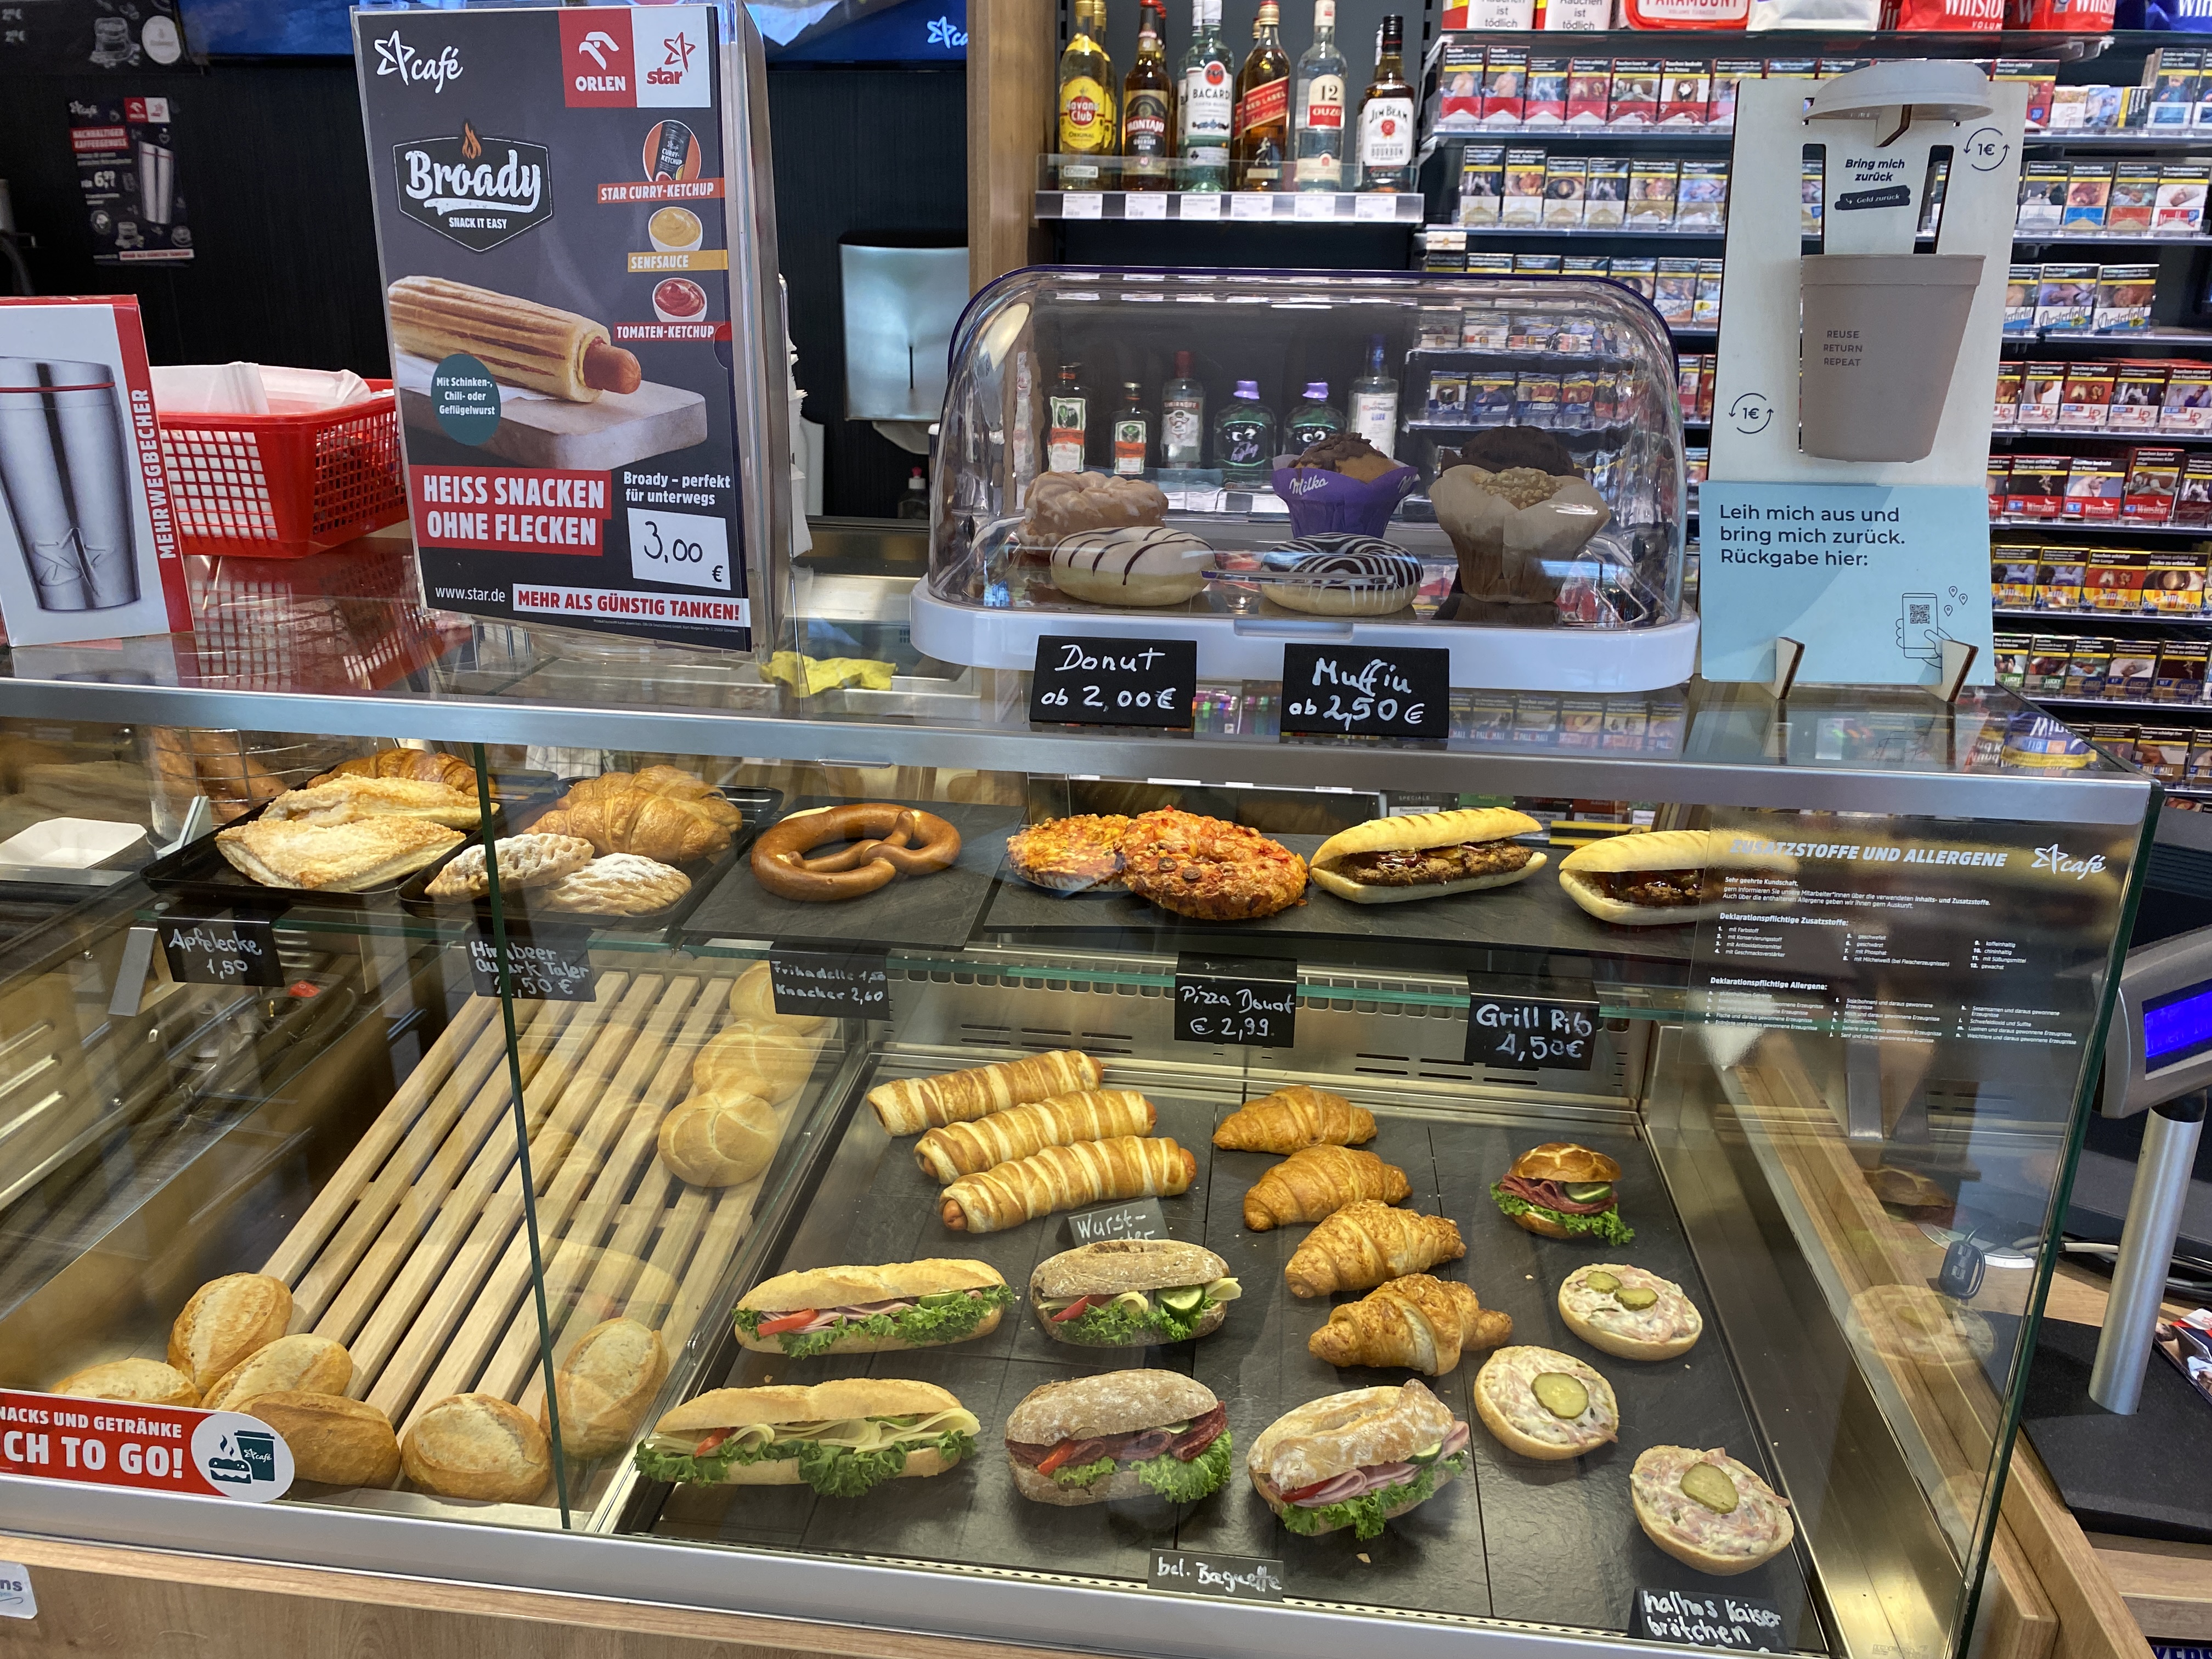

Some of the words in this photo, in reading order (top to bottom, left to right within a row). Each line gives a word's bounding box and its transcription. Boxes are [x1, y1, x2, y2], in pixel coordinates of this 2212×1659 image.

[1496, 7, 1508, 15] ist
[1573, 8, 1586, 18] ist
[411, 46, 464, 93] café
[646, 67, 683, 86] star
[575, 75, 626, 92] ORLEN
[1320, 85, 1339, 102] 12
[1071, 111, 1092, 121] Club
[1369, 109, 1384, 123] JIM
[1387, 105, 1407, 122] BEAM
[662, 148, 679, 158] CURRY-
[1978, 144, 1995, 156] 1€
[661, 154, 682, 165] KETCHUP
[1845, 159, 1875, 171] Bring
[1878, 159, 1905, 168] mich
[405, 149, 541, 214] Broady
[1855, 171, 1893, 182] zurück
[601, 187, 626, 201] STAR
[629, 182, 714, 200] CURRY-KETCHUP
[1857, 195, 1874, 204] Geld
[1875, 193, 1900, 202] zurück
[449, 217, 476, 228] SNACK
[477, 218, 484, 228] IT
[487, 218, 507, 229] EASY
[631, 255, 689, 269] SENFSAUCE
[617, 326, 715, 338] TOMATEN-KETCHUP
[1827, 330, 1860, 338] REUSE
[1824, 344, 1863, 353] RETURN
[1824, 358, 1861, 366] REPEAT
[437, 377, 449, 386] Mit
[451, 377, 492, 388] Schinken-,
[444, 391, 465, 401] Chili-
[467, 391, 486, 402] oder
[439, 405, 495, 416] Geflügelwurst
[1743, 407, 1759, 420] 1€
[131, 389, 177, 559] MEHRWEGBECHER
[624, 472, 668, 488] Broady
[681, 475, 730, 489] perfekt
[424, 475, 487, 504] HEISS
[494, 477, 604, 508] SNACKEN
[1289, 475, 1329, 495] Milka
[626, 489, 644, 502] für
[647, 491, 715, 506] unterwegs
[1720, 504, 1759, 520] Leih
[1767, 505, 1815, 521] mich
[1821, 509, 1855, 521] aus
[1861, 507, 1900, 522] und
[427, 511, 488, 540] OHNE
[495, 514, 596, 545] FLECKEN
[1720, 527, 1771, 545] bring
[1778, 527, 1826, 543] mich
[1832, 529, 1905, 545] zurück.
[644, 521, 703, 563] 3,00
[1720, 549, 1819, 568] Rückgabe
[1825, 550, 1869, 566] hier:
[712, 565, 723, 582] €
[436, 585, 505, 603] www.star.de
[518, 590, 560, 608] MEHR
[565, 594, 592, 610] ALS
[597, 592, 665, 616] GÜNSTIG
[669, 600, 740, 620] TANKEN!
[1054, 645, 1166, 672] Donut
[1312, 657, 1412, 693] Muffin
[1041, 687, 1068, 707] ab
[1289, 697, 1317, 716] ab
[1729, 839, 1859, 859] ZUSATZSTOFFE
[1863, 847, 1901, 861] UND
[1903, 849, 2008, 867] ALLERGENE
[2059, 855, 2106, 880] café
[1797, 896, 1824, 905] Allergene
[1720, 912, 1799, 924] Deklarationspflichtige
[1801, 917, 1849, 927] Zusatzstoffe:
[169, 928, 262, 955] Apfelecke
[207, 958, 248, 979] 1,50
[544, 961, 589, 979] Taler
[1711, 977, 1789, 988] Deklarationspflichtige
[1790, 981, 1828, 991] Allergene:
[1180, 985, 1231, 1006] Pizza
[1476, 1003, 1539, 1029] Grill
[1550, 1009, 1592, 1037] Rib
[1190, 1018, 1214, 1035] €
[1221, 1018, 1268, 1041] 2,99
[53, 1412, 88, 1429] UND
[94, 1416, 182, 1438] GETRÄNKE
[61, 1436, 106, 1470] TO
[119, 1443, 183, 1479] GO!
[253, 1453, 272, 1463] café
